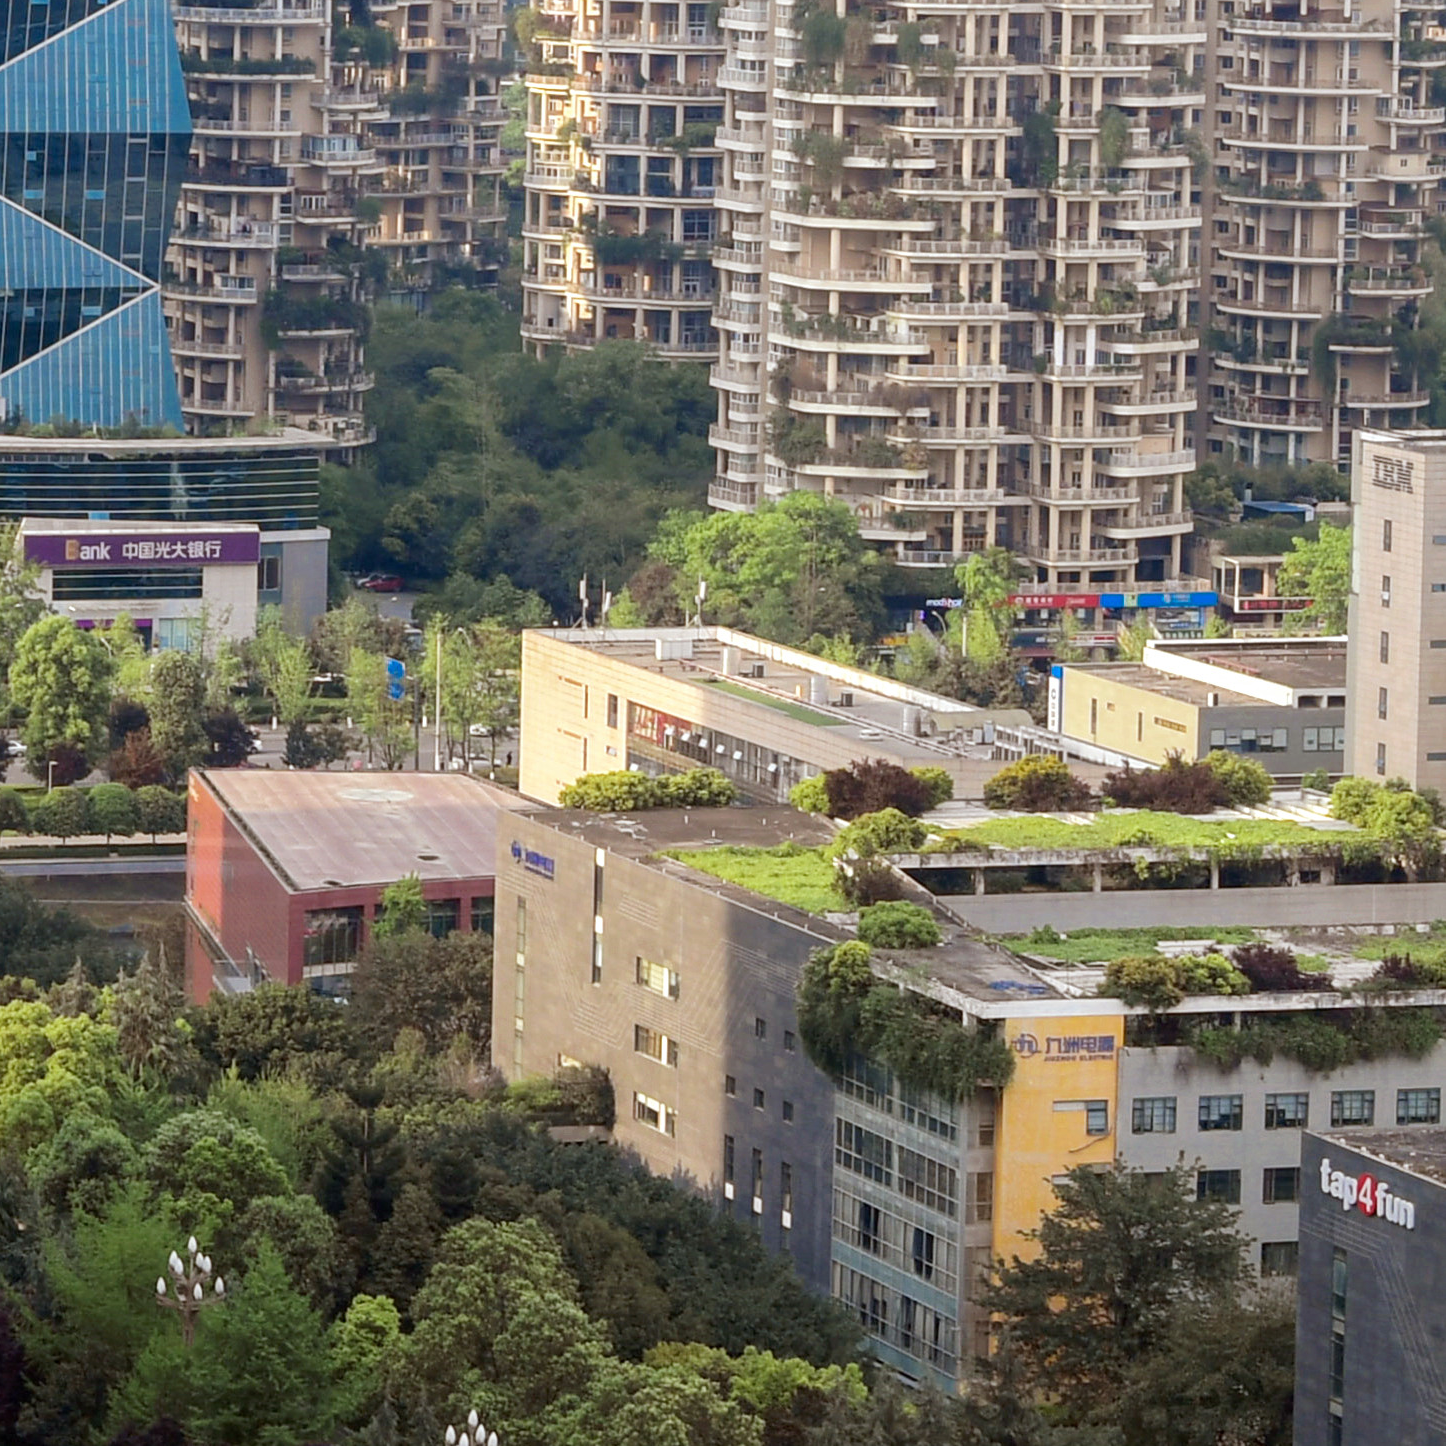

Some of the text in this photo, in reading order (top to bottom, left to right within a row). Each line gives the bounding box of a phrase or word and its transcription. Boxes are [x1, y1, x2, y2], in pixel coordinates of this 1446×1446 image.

[1372, 454, 1414, 494] IBM
[65, 539, 222, 560] Bank 中国光大银行
[1320, 1158, 1414, 1230] tap4fun
